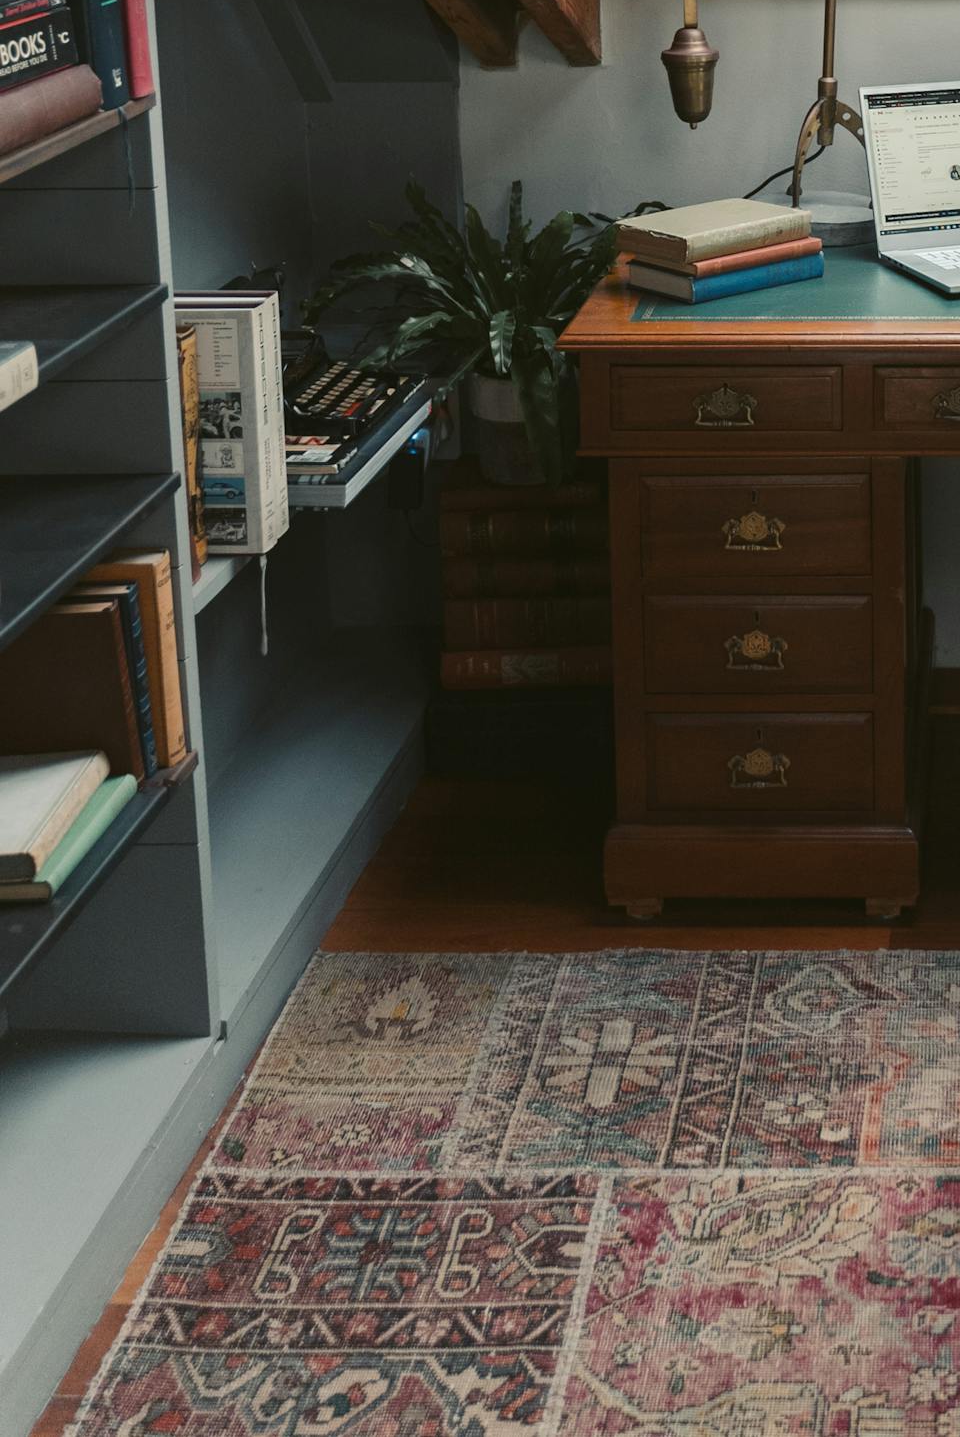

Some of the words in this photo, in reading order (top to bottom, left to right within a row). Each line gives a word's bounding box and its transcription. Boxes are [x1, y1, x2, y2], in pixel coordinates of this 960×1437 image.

[0, 31, 46, 66] BOOKS
[258, 312, 269, 425] PORSCHE
[271, 303, 282, 413] PORSCHE
